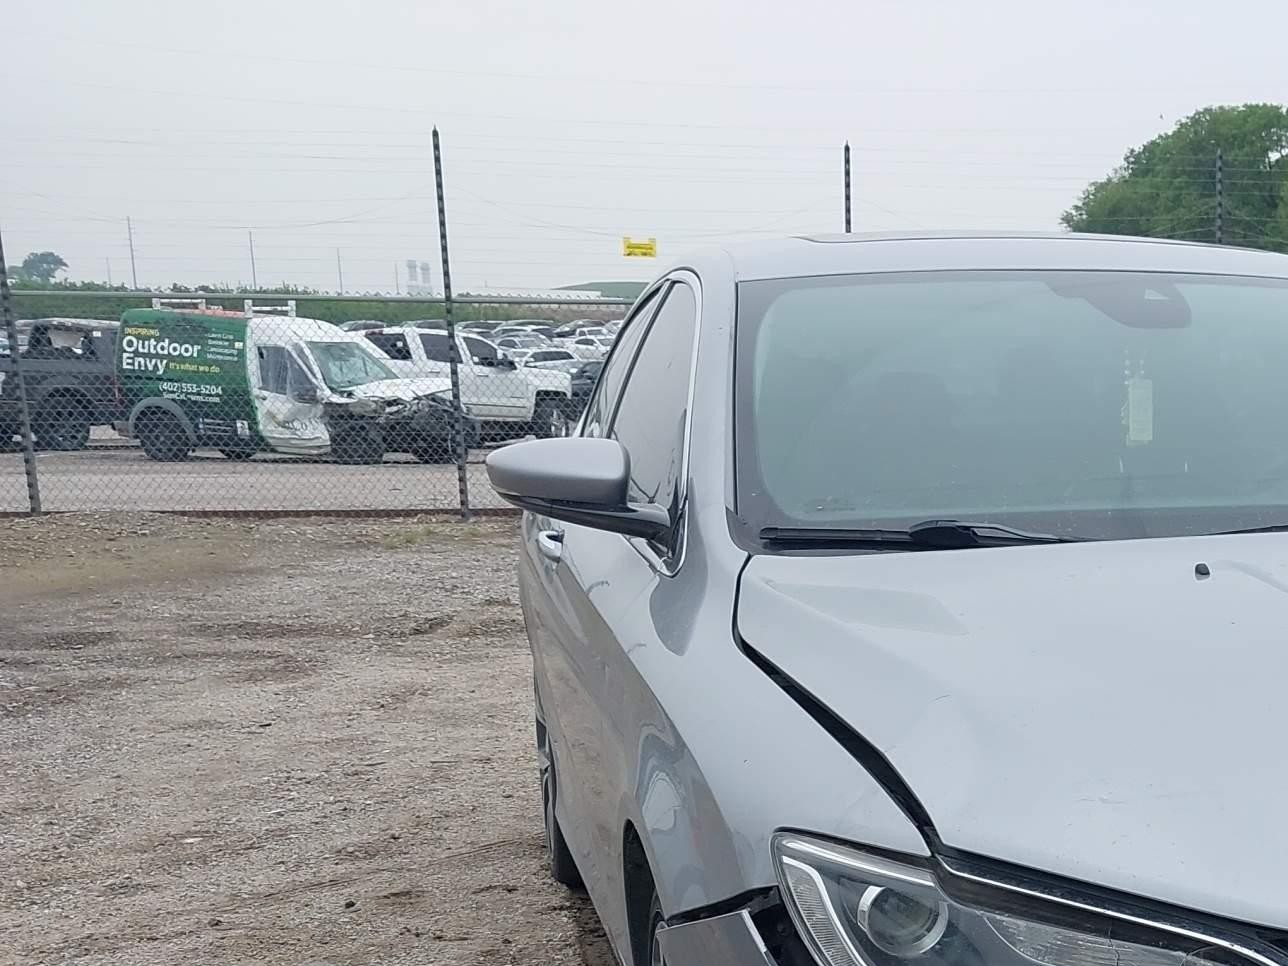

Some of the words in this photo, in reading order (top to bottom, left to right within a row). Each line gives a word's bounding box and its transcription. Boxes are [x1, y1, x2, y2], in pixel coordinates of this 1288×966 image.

[122, 335, 201, 357] Outdoor
[122, 353, 168, 375] Envy
[209, 364, 220, 373] do
[159, 381, 181, 393] (402)
[181, 383, 222, 395] 553-5204
